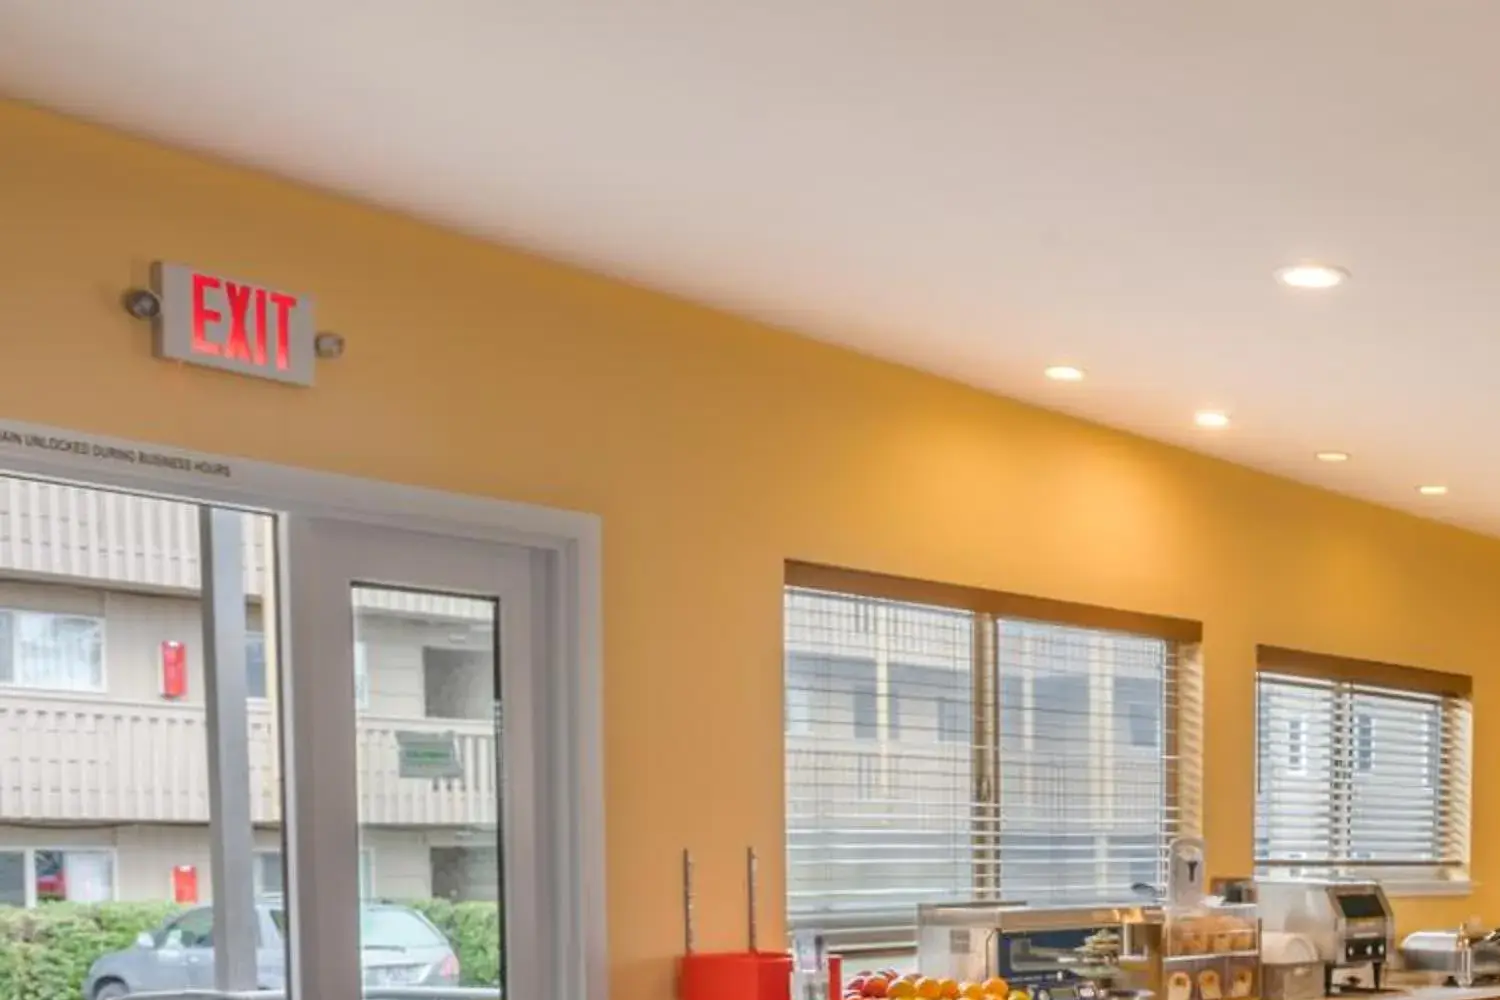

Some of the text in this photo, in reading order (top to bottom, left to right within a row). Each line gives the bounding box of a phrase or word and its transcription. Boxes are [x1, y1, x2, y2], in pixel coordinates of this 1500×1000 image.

[191, 273, 297, 371] EXIT
[25, 434, 90, 455] UNLOCKED
[93, 444, 135, 463] DURING
[138, 450, 191, 471] BUSINESS
[194, 460, 231, 478] HOURS
